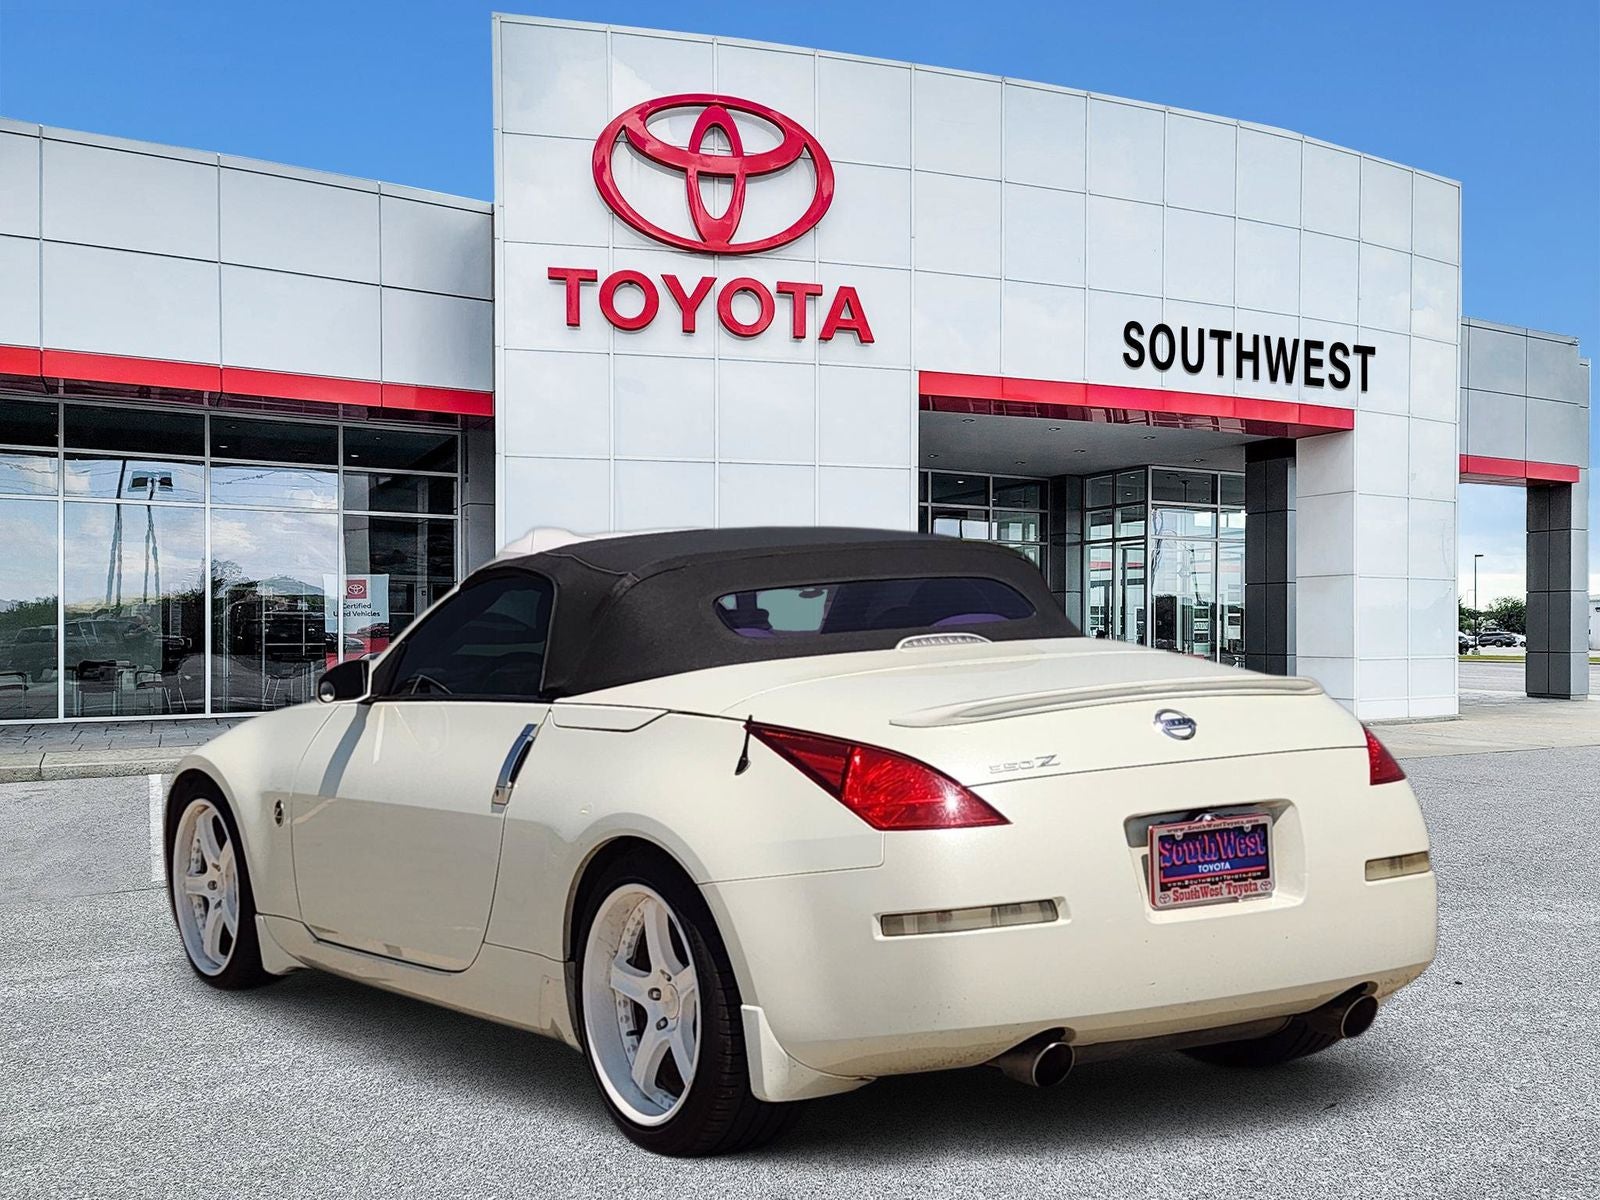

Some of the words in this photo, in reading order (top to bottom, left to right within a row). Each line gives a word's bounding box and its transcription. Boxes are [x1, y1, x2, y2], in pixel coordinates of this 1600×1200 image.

[548, 267, 874, 343] TOYOTA
[1122, 320, 1376, 392] SOUTHWEST
[343, 602, 372, 610] Certified
[1198, 861, 1231, 873] TOYOTA
[1173, 884, 1223, 902] SouthWest
[1225, 880, 1259, 897] Toyota
